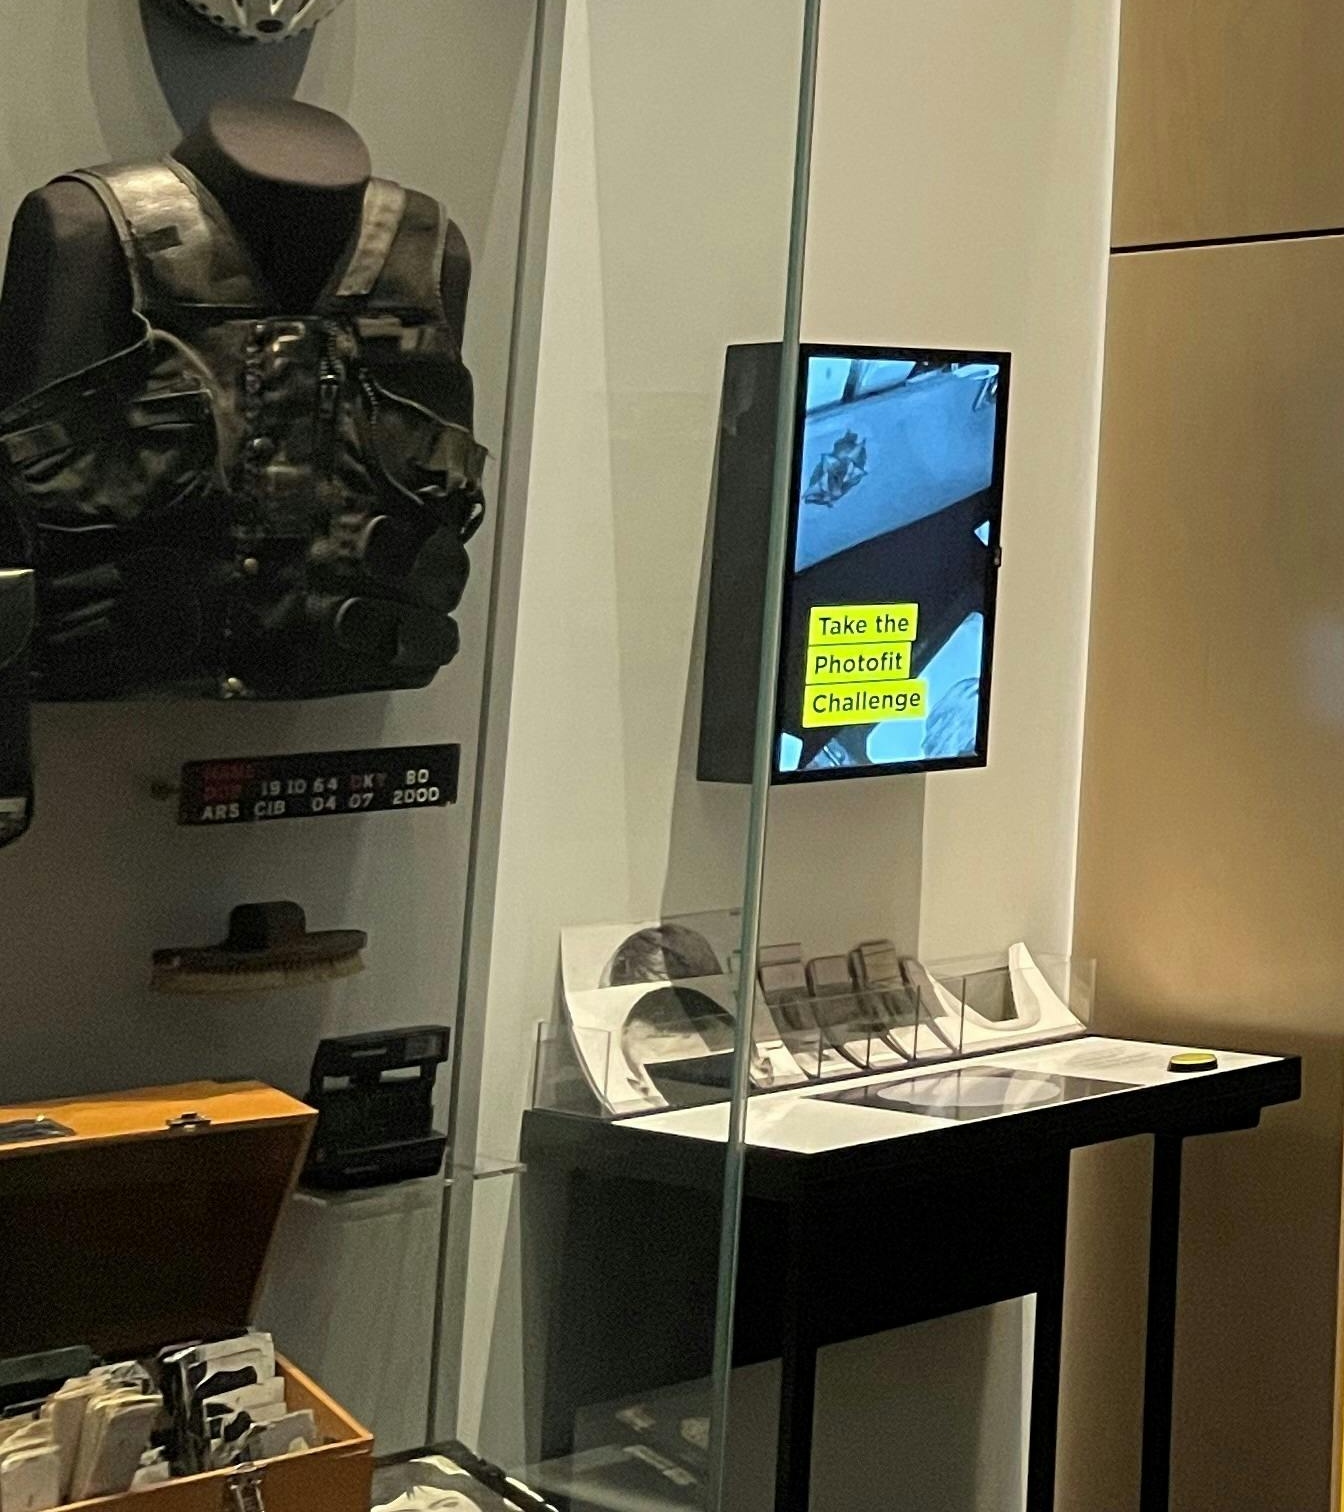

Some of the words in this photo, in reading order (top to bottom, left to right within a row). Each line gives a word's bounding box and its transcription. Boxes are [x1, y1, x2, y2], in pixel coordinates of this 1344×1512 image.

[819, 616, 867, 636] Take
[876, 614, 909, 633] the
[814, 652, 902, 675] Photofit
[812, 690, 921, 714] Challenge
[200, 803, 240, 820] ARS
